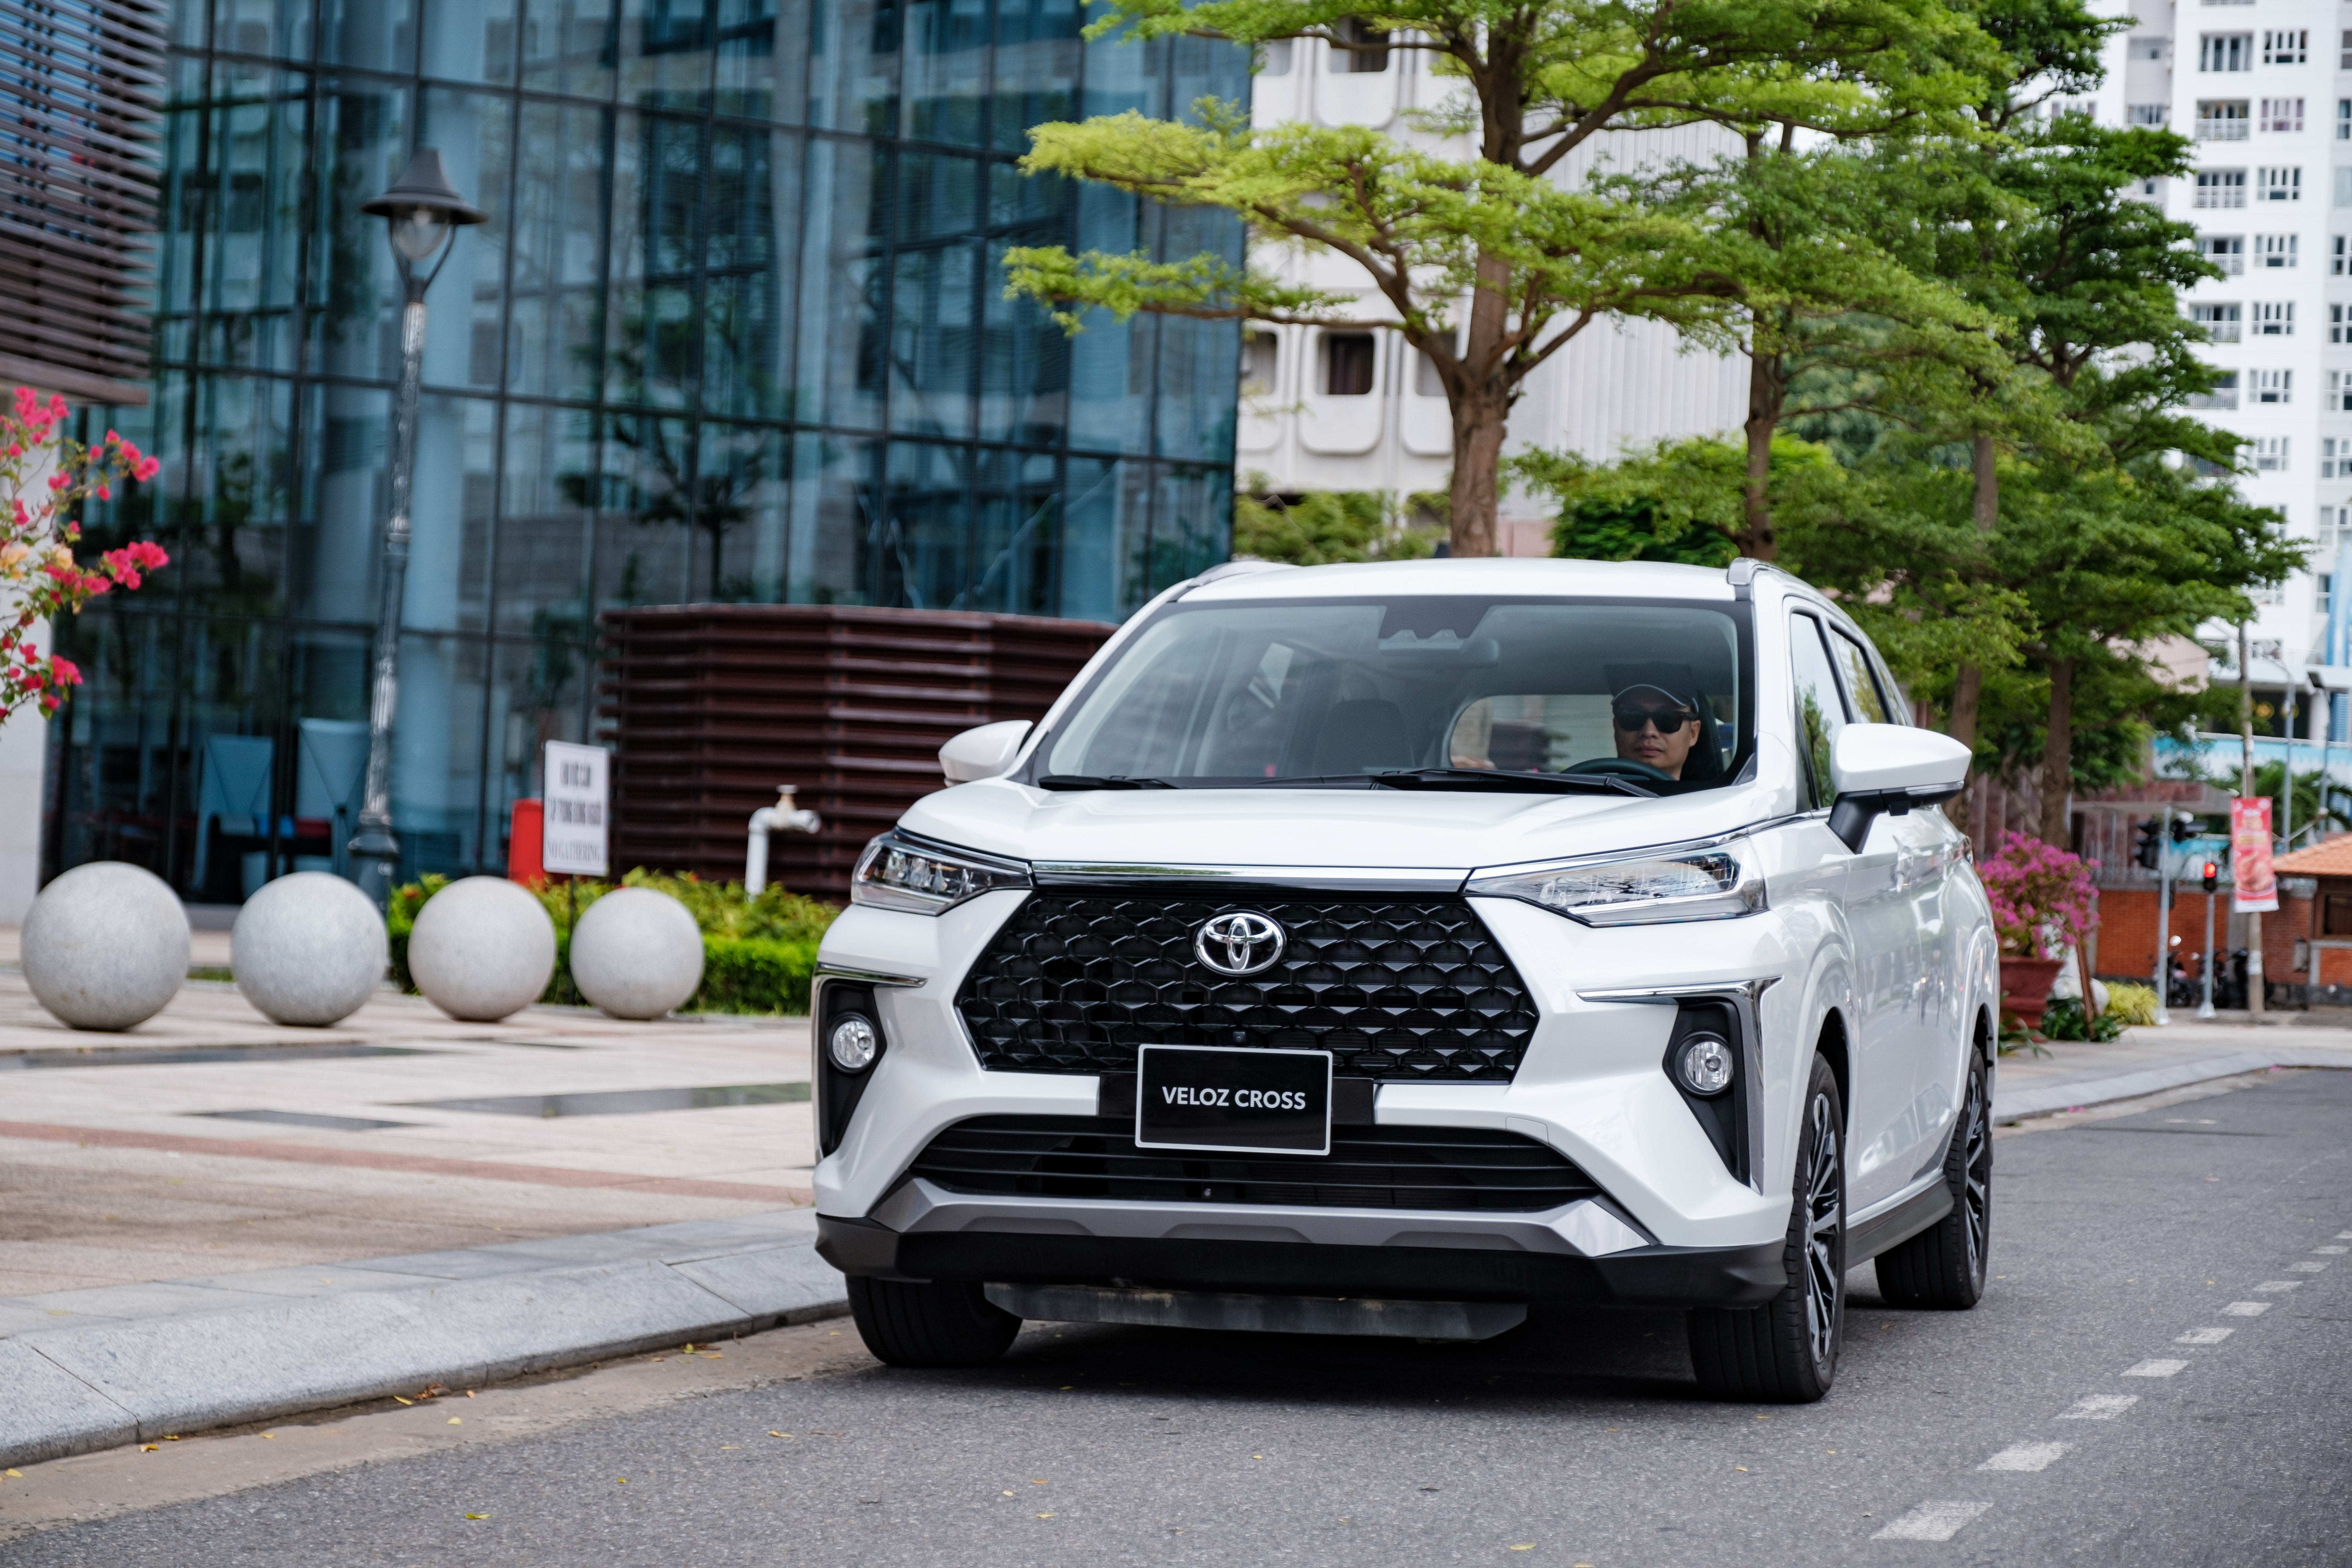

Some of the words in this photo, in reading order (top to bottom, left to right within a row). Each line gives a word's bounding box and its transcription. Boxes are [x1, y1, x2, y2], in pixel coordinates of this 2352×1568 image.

[547, 839, 557, 859] NO
[558, 840, 600, 862] GATHERING
[1162, 1086, 1230, 1106] VELOZ
[1234, 1090, 1306, 1110] CROSS
